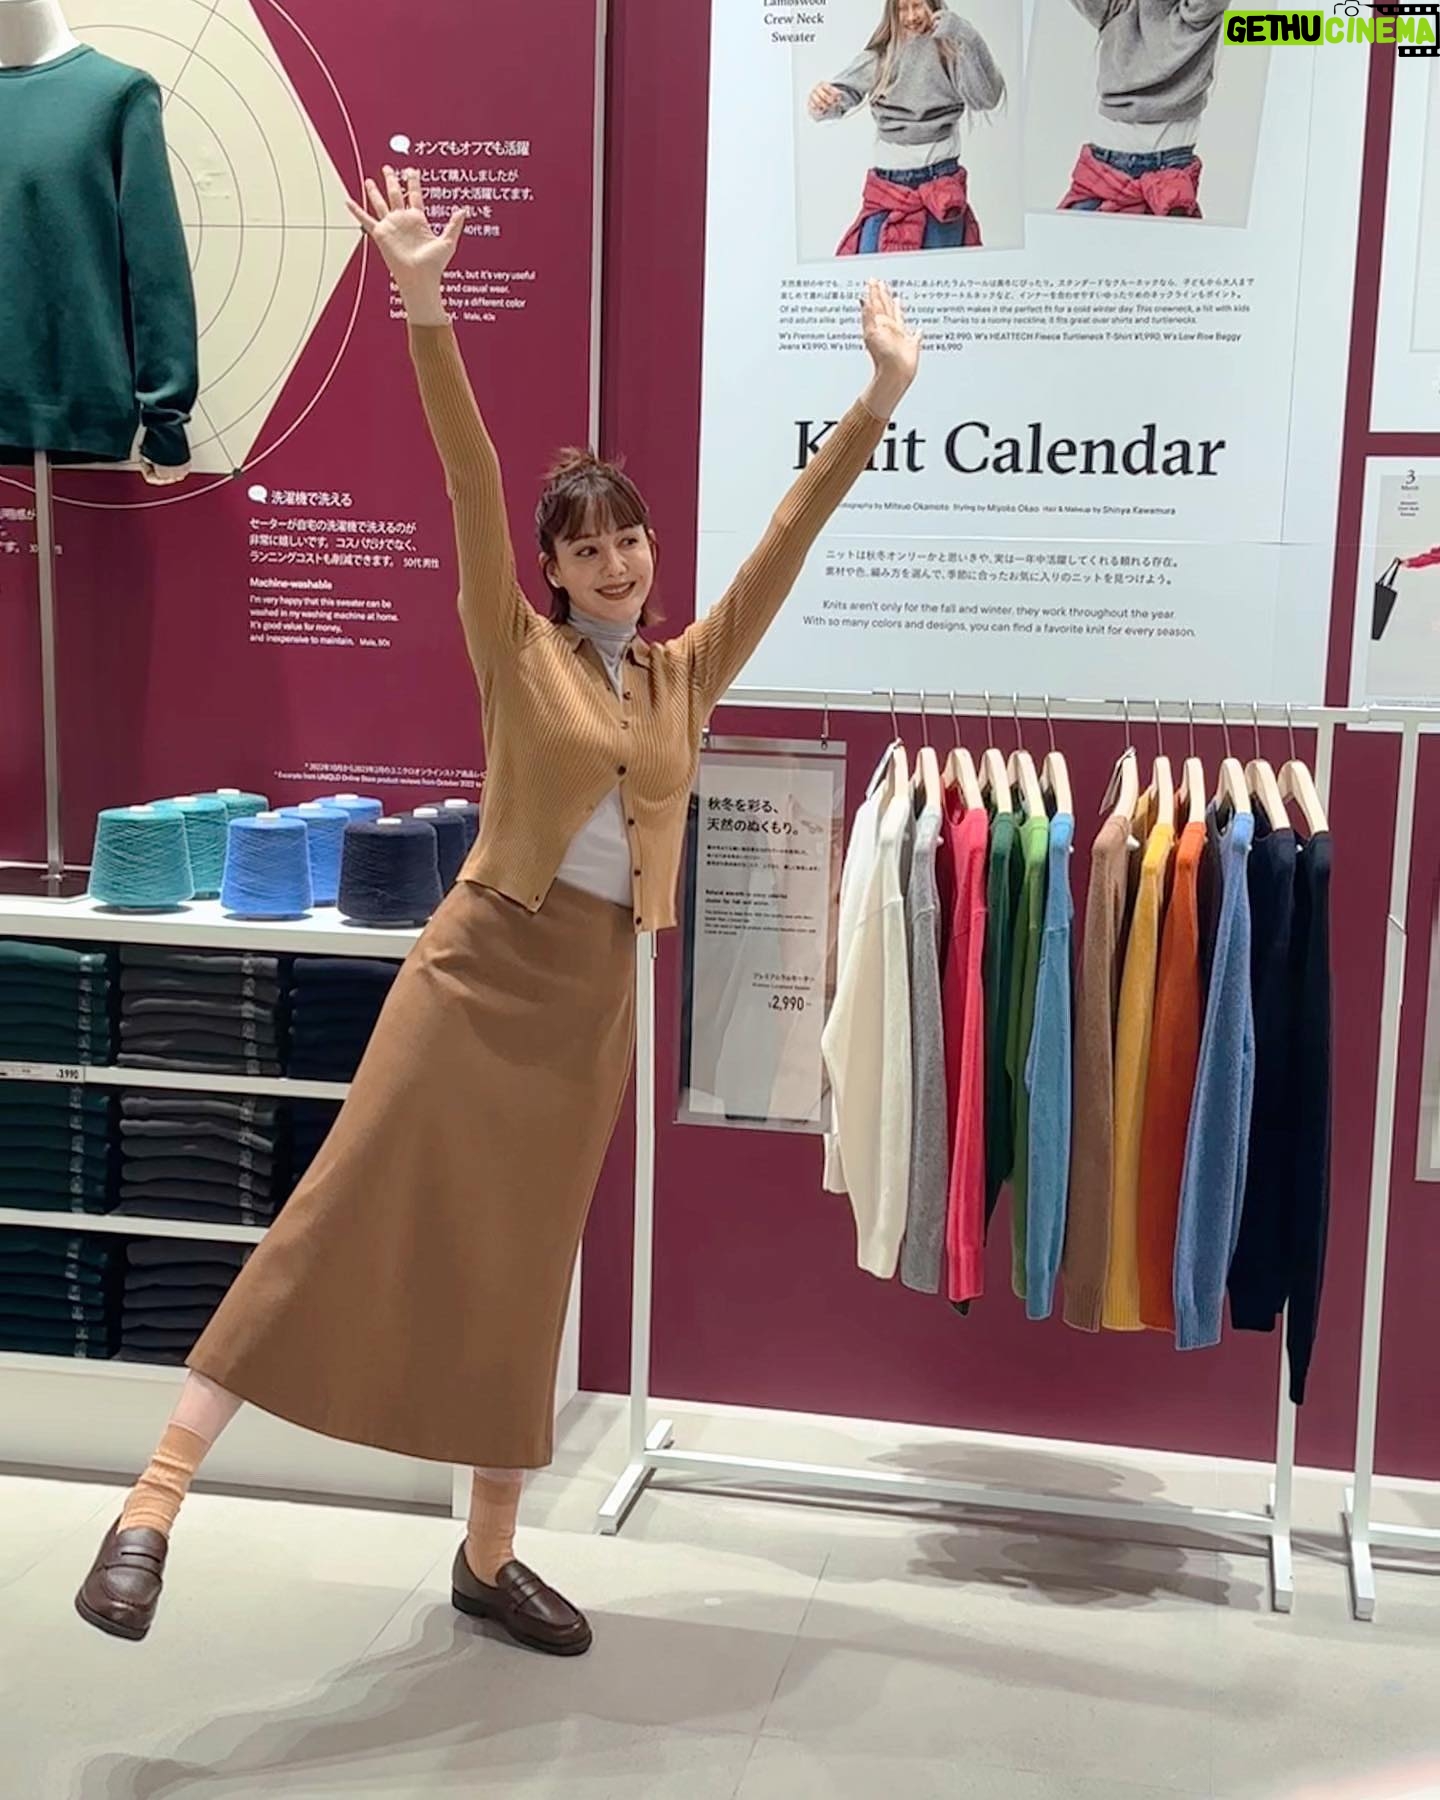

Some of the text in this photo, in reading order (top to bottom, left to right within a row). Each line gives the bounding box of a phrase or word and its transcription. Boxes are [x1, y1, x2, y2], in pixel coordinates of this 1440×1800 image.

[764, 13, 824, 24] Crew Neck
[771, 32, 815, 42] Sweater
[414, 140, 530, 156] オンでもオフでも活躍
[466, 270, 479, 279] but
[481, 270, 492, 279] it's
[494, 273, 510, 282] very
[511, 271, 536, 280] useful
[446, 283, 460, 292] and
[462, 283, 488, 292] casual
[449, 298, 527, 308] buy different color
[801, 305, 812, 313] the
[815, 305, 840, 313] natural
[937, 305, 965, 313] warmth
[1014, 305, 1042, 314] perfect
[1073, 304, 1090, 312] cold
[1093, 304, 1116, 312] winter
[1137, 304, 1152, 312] This
[1216, 304, 1232, 312] with
[1234, 304, 1250, 312] kids
[780, 316, 793, 324] and
[943, 316, 969, 324] Thanks
[1070, 316, 1090, 326] great
[1112, 316, 1132, 324] shirts
[1135, 316, 1150, 324] and
[793, 332, 825, 340] Premium
[975, 332, 988, 340] W's
[989, 332, 1033, 340] HEATTECH
[1035, 332, 1060, 340] Fleece
[1063, 332, 1103, 340] Turtleneck
[1106, 332, 1132, 340] T-Shirt
[1163, 332, 1176, 340] W's
[1179, 332, 1195, 340] Low
[1216, 332, 1242, 342] Baggy
[779, 343, 800, 351] Jeans
[830, 343, 843, 351] W's
[793, 421, 1226, 475] Kit Calendar
[1406, 470, 1415, 484] 3
[271, 490, 353, 507] 洗濯機で洗える
[884, 502, 911, 510] Mitsuo
[913, 503, 949, 511] Okamoto
[1103, 505, 1131, 515] Shinya
[1133, 506, 1176, 514] Kawamura
[250, 518, 417, 534] セーターが自宅の洗濯機で洗えるのが
[250, 578, 333, 589] Machine-washable
[263, 597, 278, 605] very
[280, 596, 302, 606] happy
[304, 597, 319, 605] that
[320, 597, 334, 606] this
[336, 598, 364, 607] sweater
[382, 600, 392, 608] be
[250, 609, 279, 617] washed
[301, 610, 332, 621] washing
[333, 611, 365, 620] machine
[822, 601, 847, 610] Knits
[850, 601, 879, 611] aren't
[880, 602, 901, 614] only
[904, 603, 918, 612] for
[921, 603, 938, 612] the
[940, 604, 956, 613] fall
[959, 604, 978, 613] and
[1016, 606, 1039, 617] they
[1042, 607, 1067, 616] work
[1069, 608, 1128, 619] throughout
[1131, 609, 1148, 618] the
[263, 621, 281, 631] good
[283, 622, 303, 630] value
[304, 622, 315, 631] for
[803, 616, 826, 626] With
[842, 620, 870, 629] many
[872, 618, 902, 628] colors
[904, 619, 923, 629] and
[969, 623, 989, 633] you
[1013, 622, 1032, 632] find
[1044, 623, 1084, 633] favorite
[1086, 624, 1105, 634] knit
[1107, 625, 1122, 634] for
[1124, 628, 1154, 637] every
[250, 634, 265, 642] and
[266, 635, 309, 645] inexpensive
[707, 797, 779, 814] 秋冬を彩る、
[707, 817, 801, 836] 天然のぬくもり。
